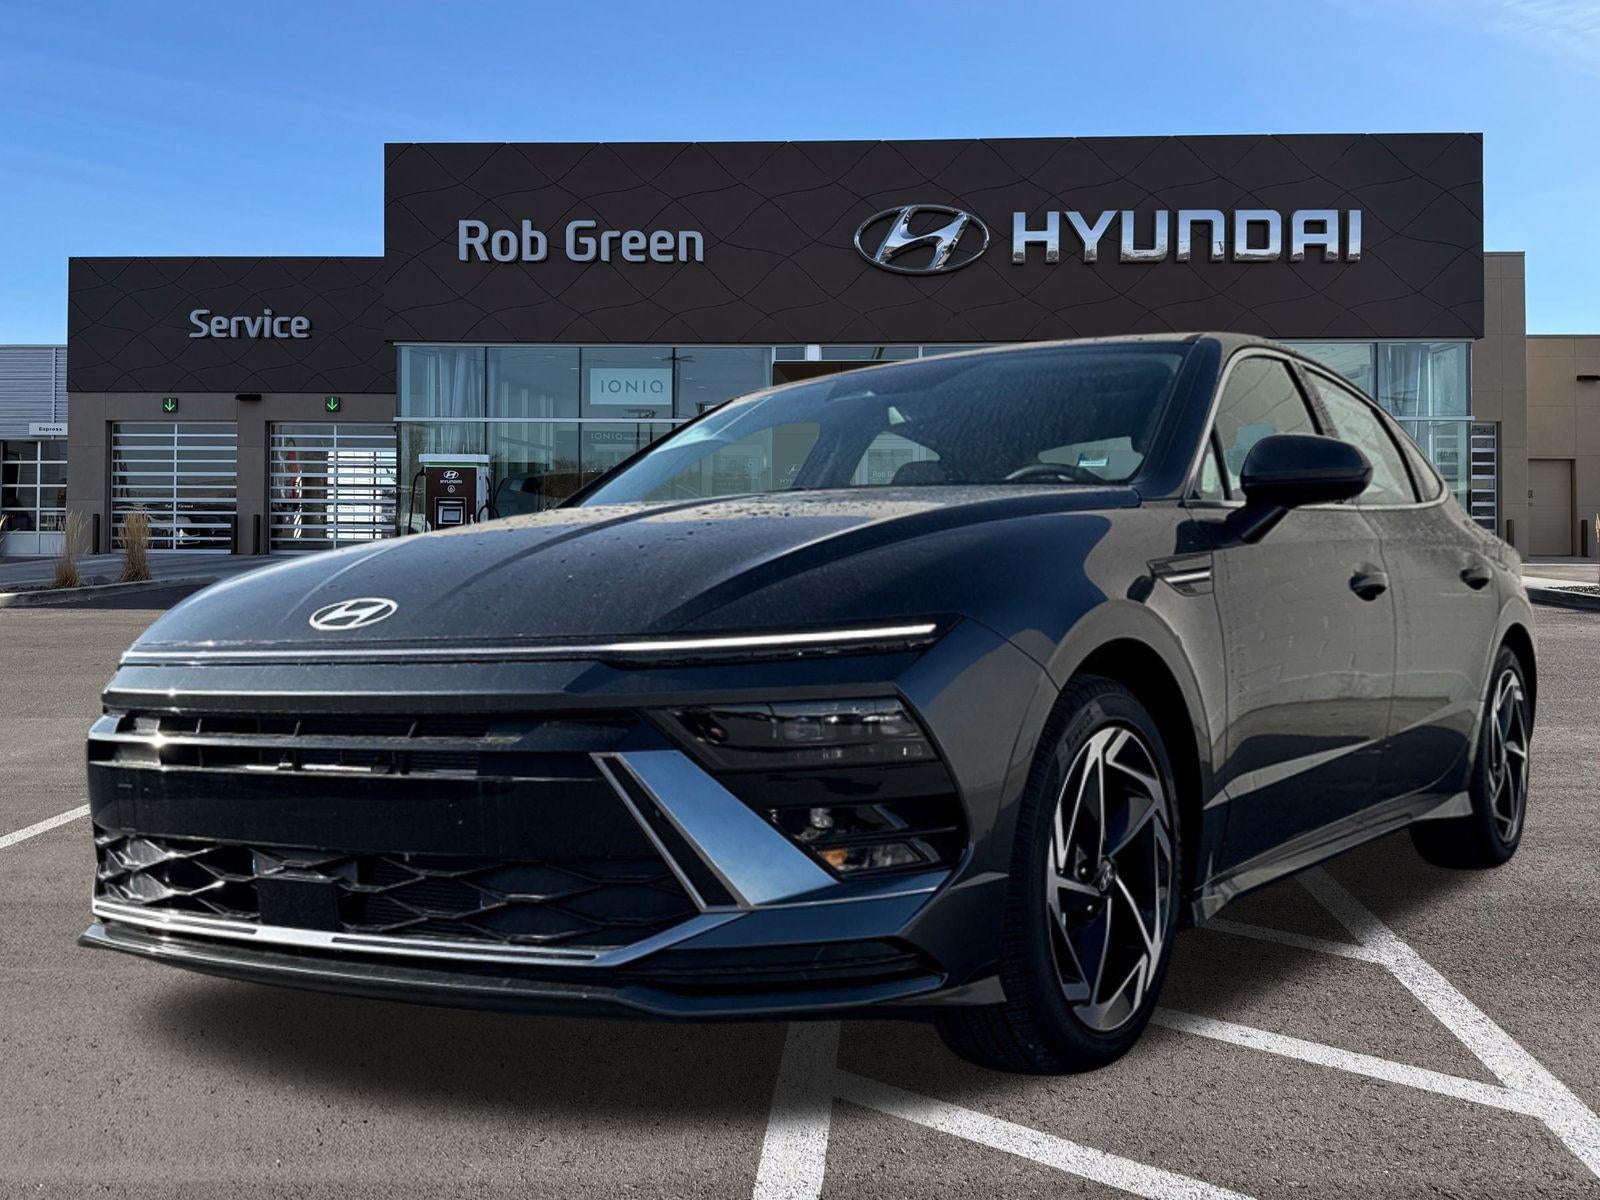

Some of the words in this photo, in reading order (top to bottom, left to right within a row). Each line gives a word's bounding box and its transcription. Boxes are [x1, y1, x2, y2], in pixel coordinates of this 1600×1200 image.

[458, 219, 548, 263] Rob
[565, 219, 704, 263] Green
[1011, 209, 1362, 264] HYUNDAI
[189, 308, 311, 338] Service
[600, 379, 664, 393] IONIQ
[591, 432, 623, 440] IONIQ
